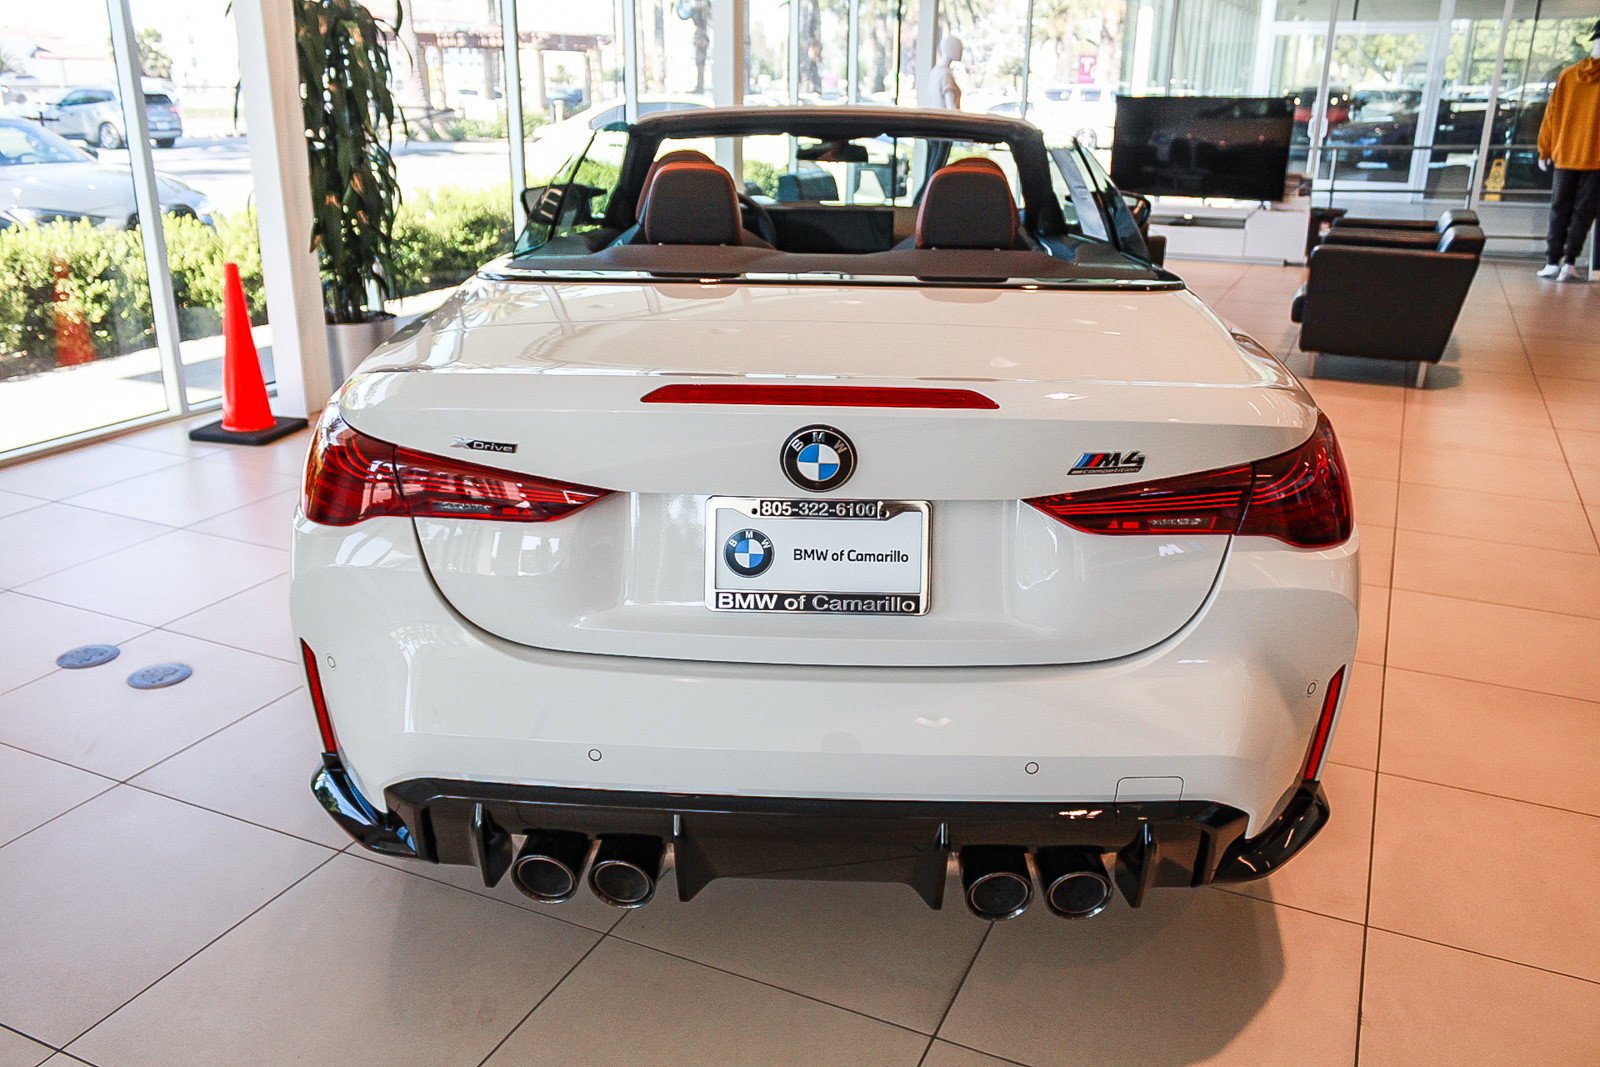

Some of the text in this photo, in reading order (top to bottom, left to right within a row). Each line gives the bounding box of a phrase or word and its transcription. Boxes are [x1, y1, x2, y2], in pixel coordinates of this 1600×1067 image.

[791, 431, 848, 454] BMW
[761, 501, 876, 517] 805-322-6100
[728, 530, 771, 549] BMW
[793, 548, 909, 563] BMW of Camarillo
[717, 592, 916, 612] BMW of Camarillo
